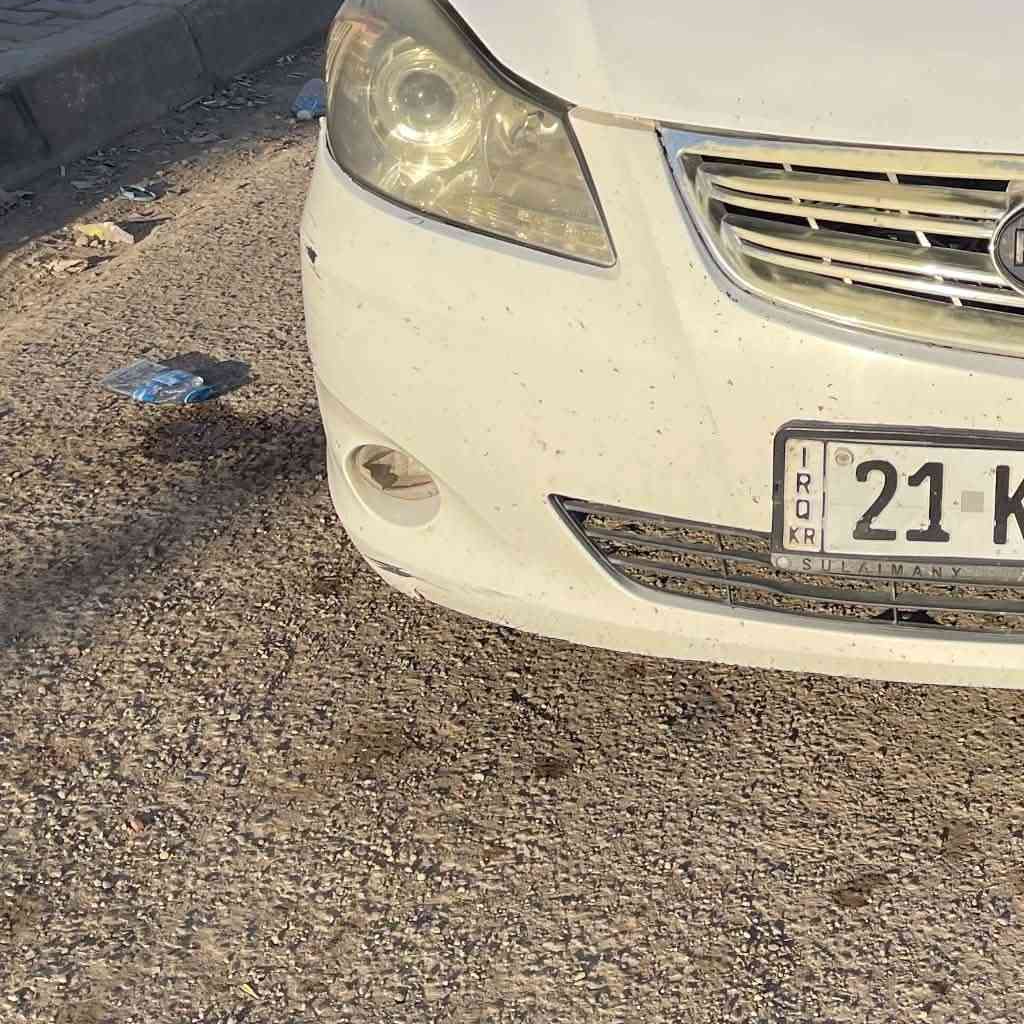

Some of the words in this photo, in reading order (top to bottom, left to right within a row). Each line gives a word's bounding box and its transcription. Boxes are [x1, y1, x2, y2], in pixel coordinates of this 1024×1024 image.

[852, 460, 950, 543] 21
[788, 527, 816, 545] KR
[801, 558, 963, 578] SULAIMANY
